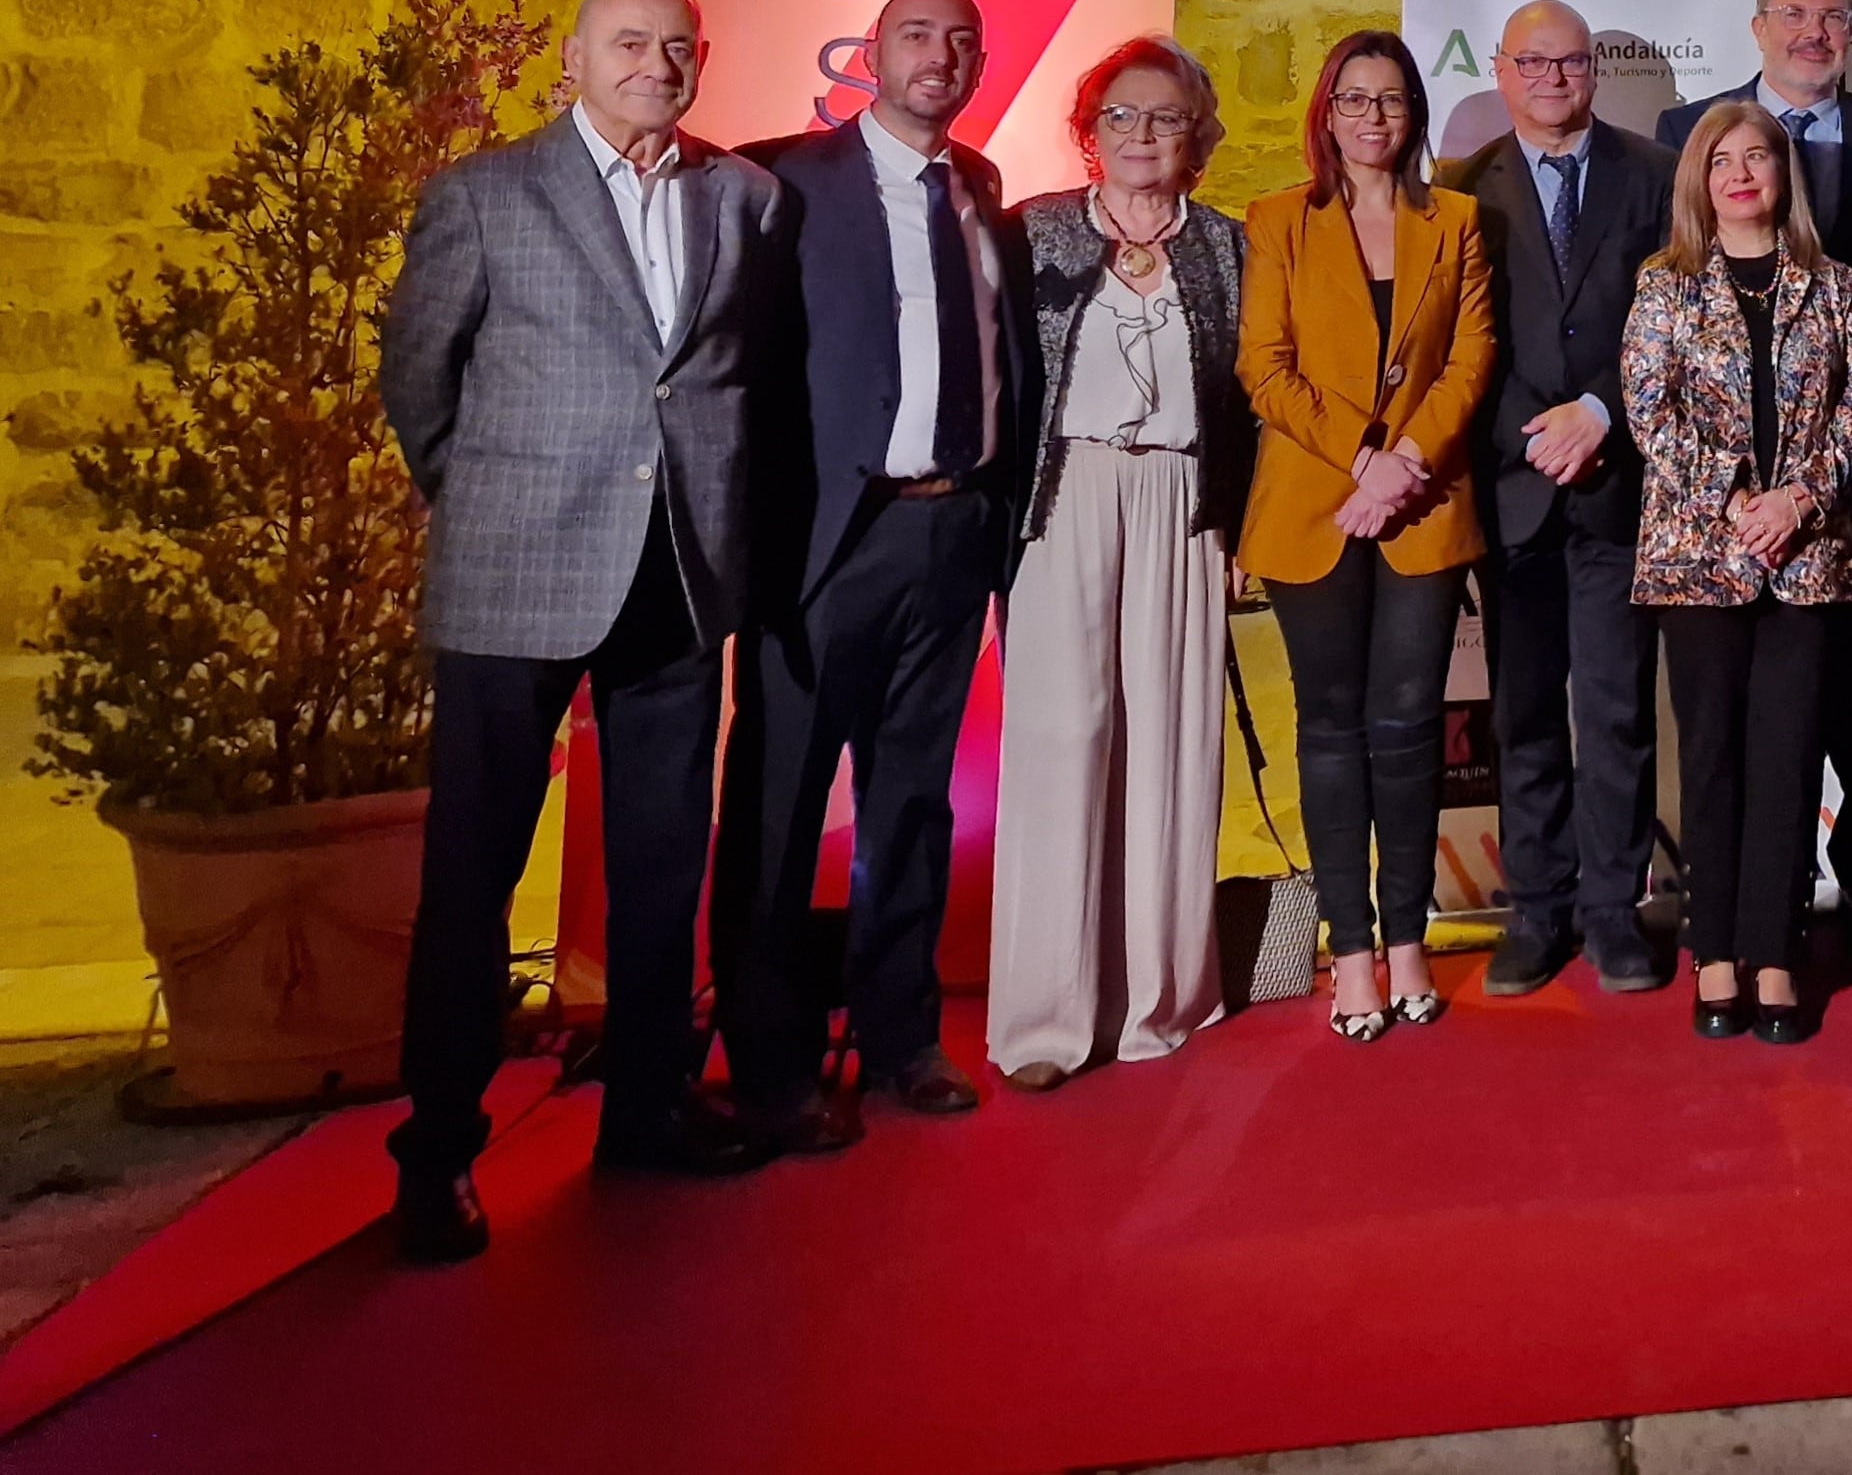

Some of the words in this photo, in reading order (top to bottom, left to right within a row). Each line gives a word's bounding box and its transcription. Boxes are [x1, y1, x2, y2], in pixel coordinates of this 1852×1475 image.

[1595, 37, 1704, 59] Andalucía
[1613, 67, 1658, 76] Turismo
[1660, 69, 1668, 78] y
[1669, 66, 1713, 78] Deporte
